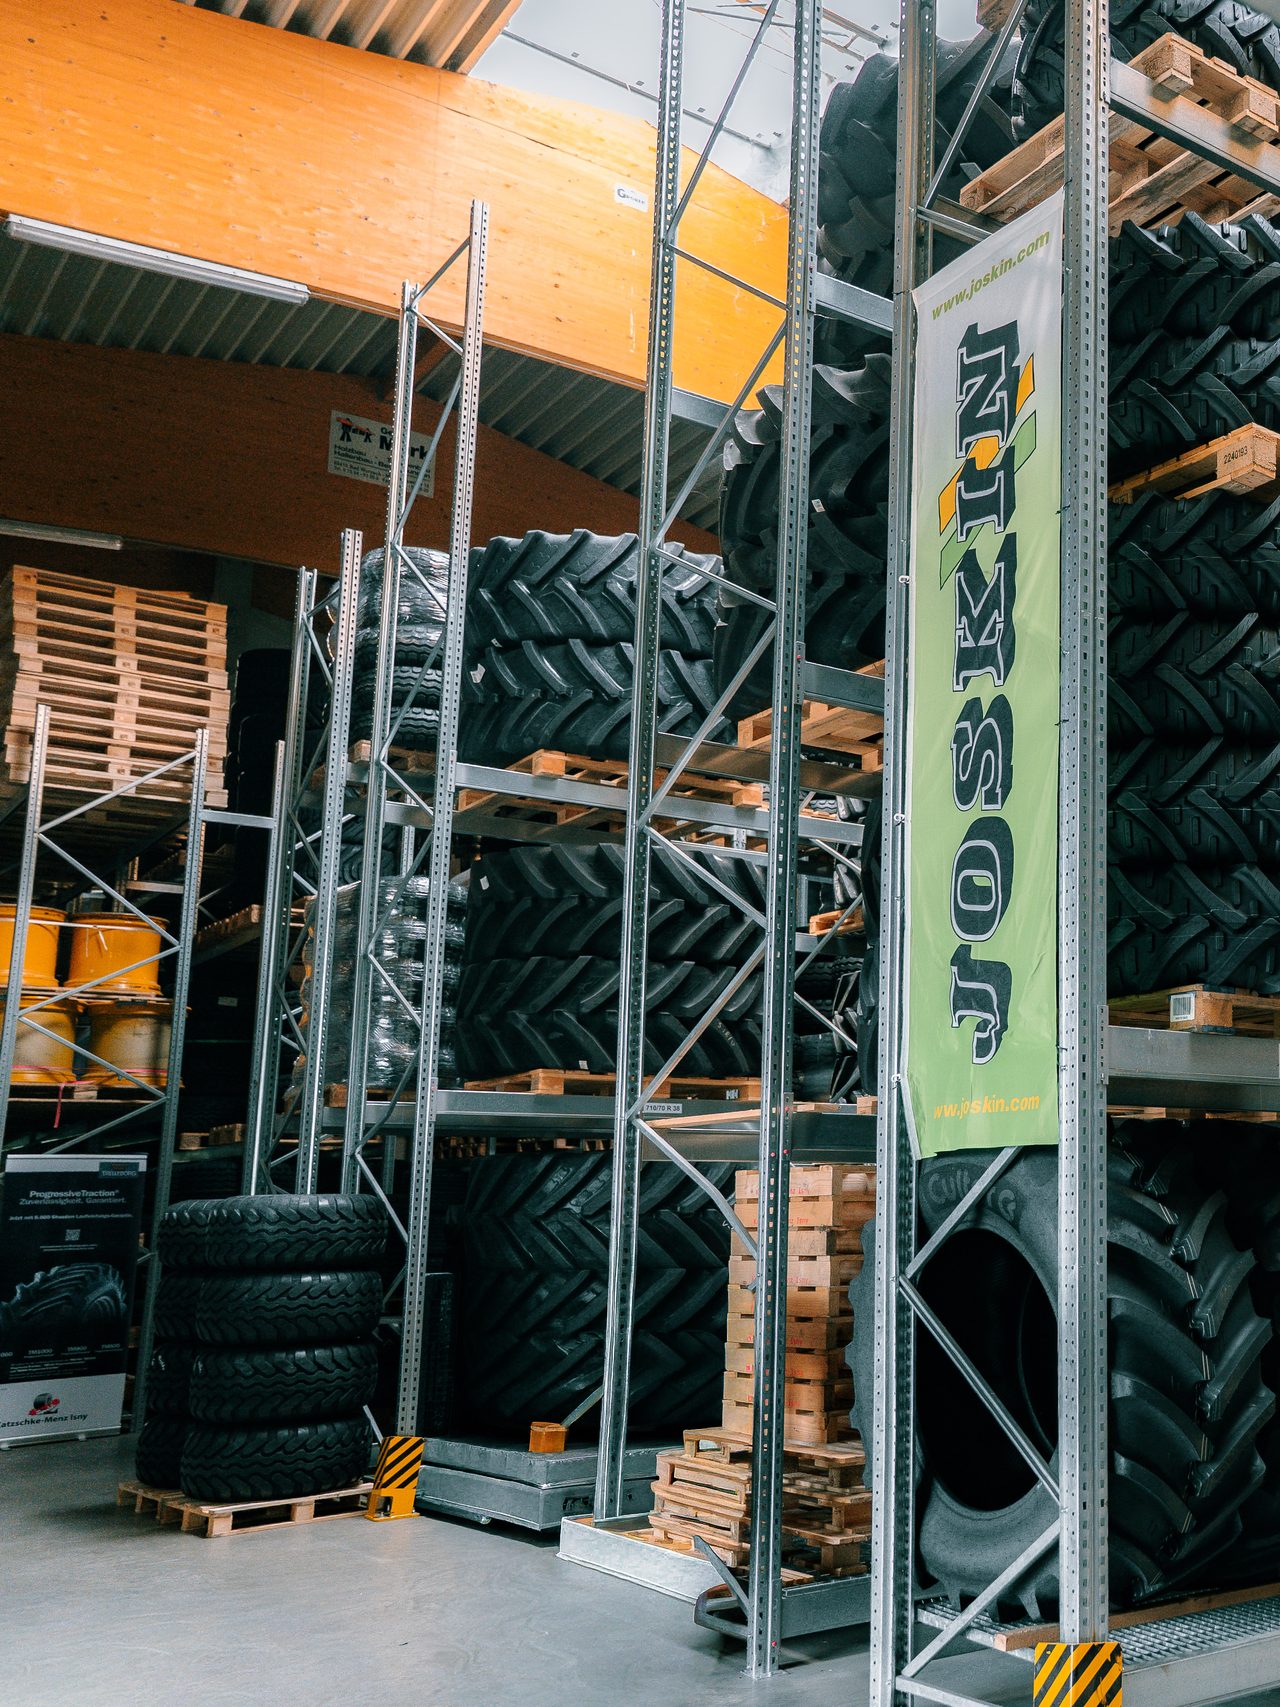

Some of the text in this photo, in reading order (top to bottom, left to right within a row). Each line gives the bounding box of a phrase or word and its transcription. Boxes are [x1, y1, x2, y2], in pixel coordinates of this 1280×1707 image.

[931, 230, 1051, 321] www.joskin.com
[379, 435, 429, 460] Mrk
[1222, 445, 1248, 465] 2240193
[950, 319, 1020, 1064] JOSKIN
[0, 1413, 88, 1428] atzschke-Menz Isny
